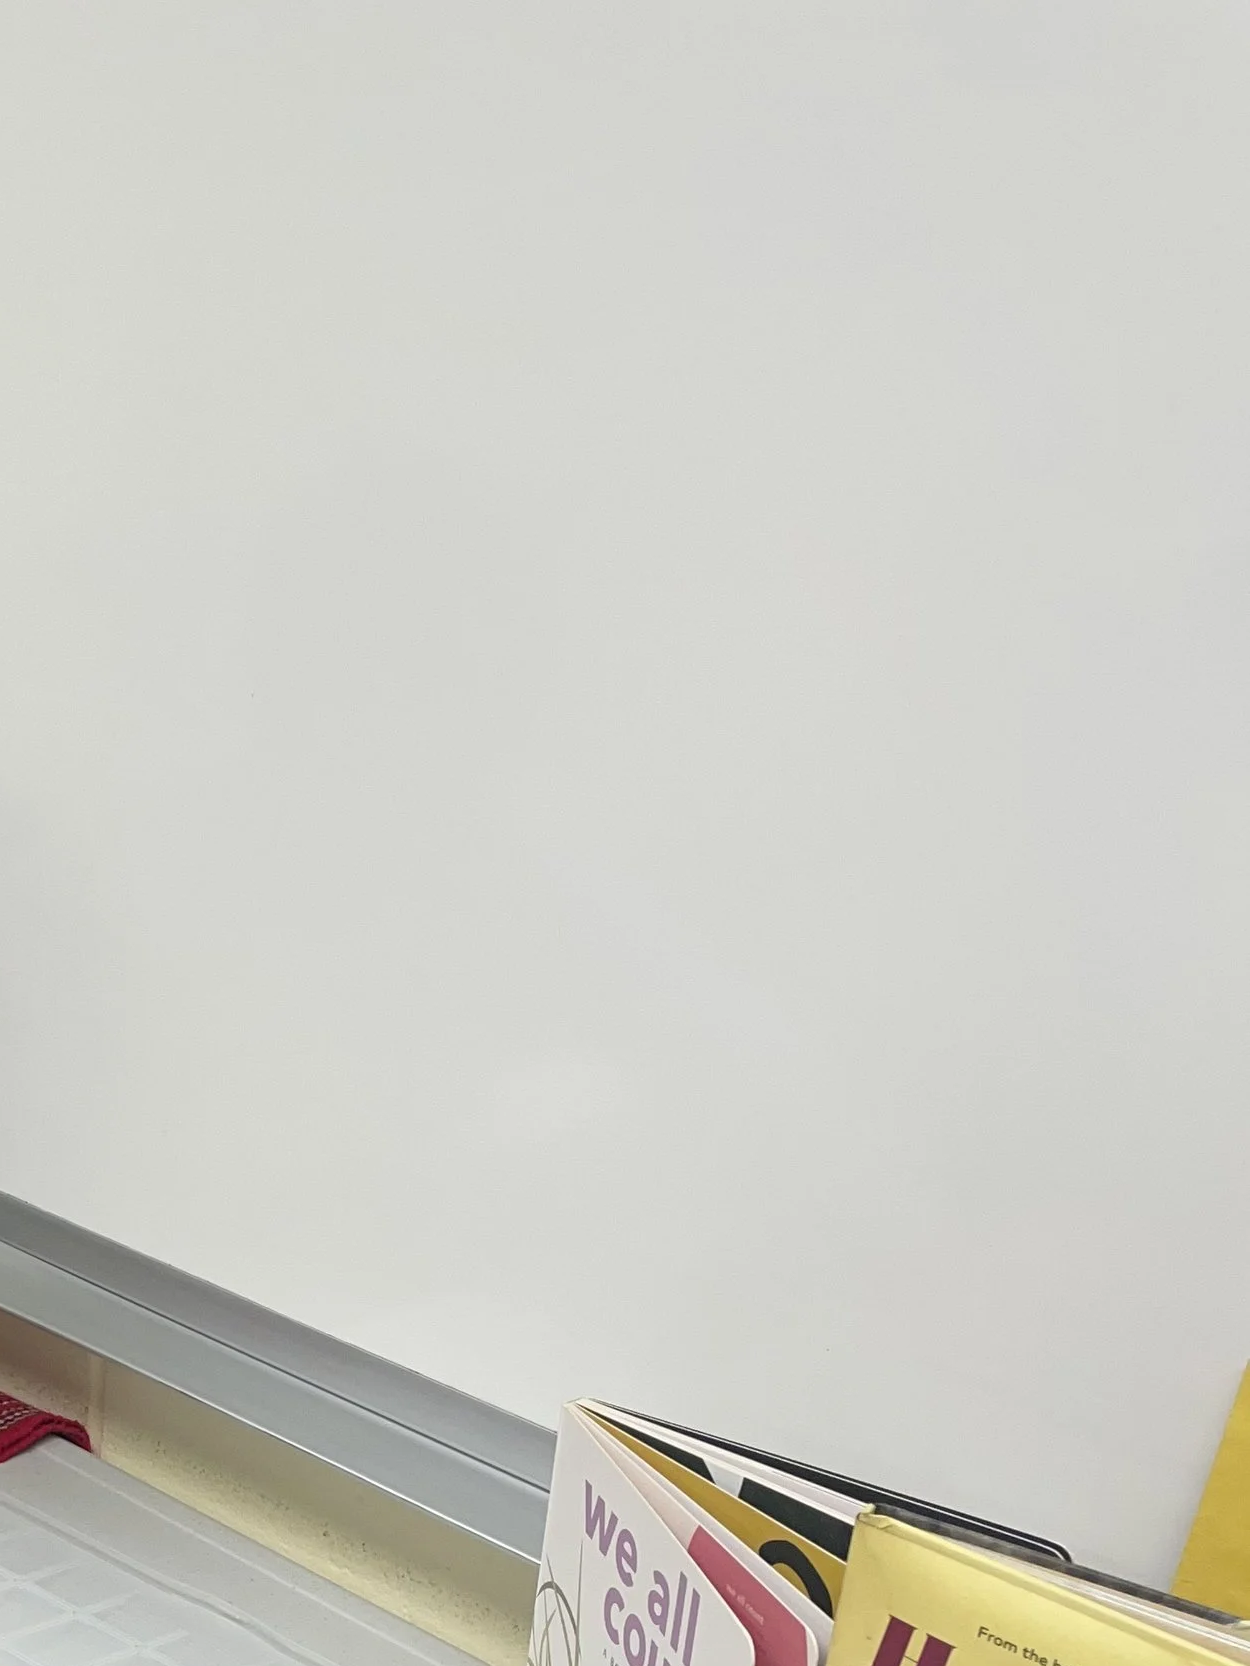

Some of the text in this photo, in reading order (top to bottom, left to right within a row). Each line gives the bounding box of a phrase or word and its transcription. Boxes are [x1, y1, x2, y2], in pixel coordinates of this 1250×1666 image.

[584, 1478, 638, 1587] we
[977, 1626, 1018, 1653] From
[1022, 1647, 1048, 1666] the
